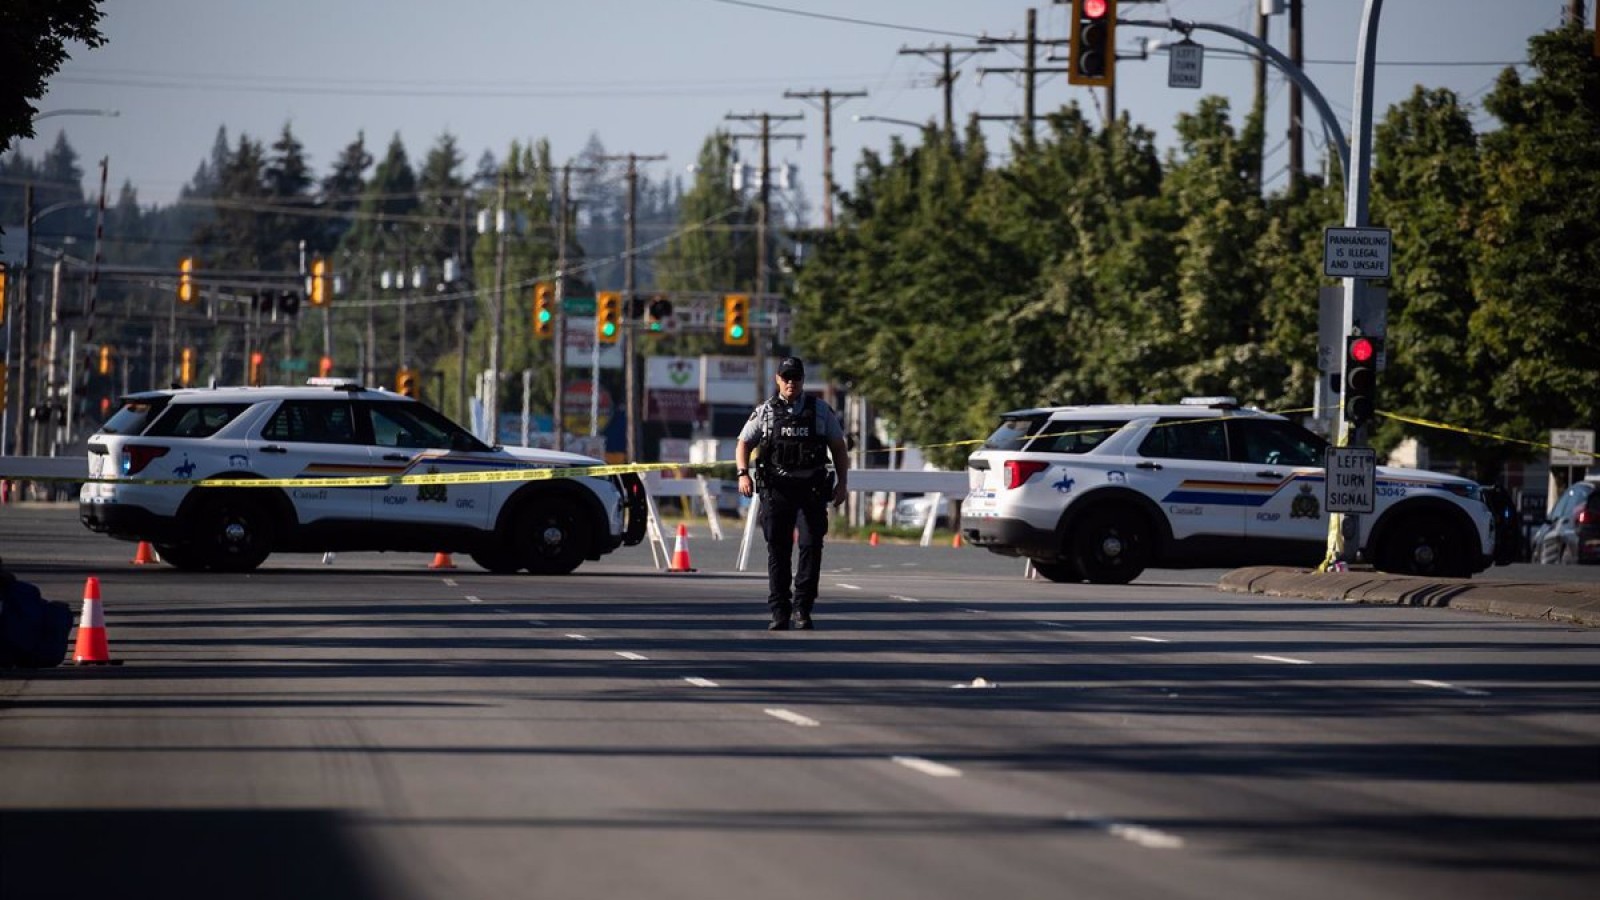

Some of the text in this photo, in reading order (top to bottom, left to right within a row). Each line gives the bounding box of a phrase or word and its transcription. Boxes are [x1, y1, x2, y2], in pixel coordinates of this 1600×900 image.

[1329, 236, 1388, 246] PANHANDLING
[1336, 248, 1378, 258] IS ILLEGAL
[1330, 260, 1384, 270] AND UNSAFE
[781, 427, 808, 436] POLICE
[1337, 455, 1364, 469] LEFT
[1336, 474, 1365, 487] TURN
[293, 489, 328, 500] Canada
[1330, 493, 1369, 506] SIGNAL
[383, 496, 408, 505] RCMP
[456, 499, 476, 508] GRC
[1256, 512, 1281, 521] RCMP
